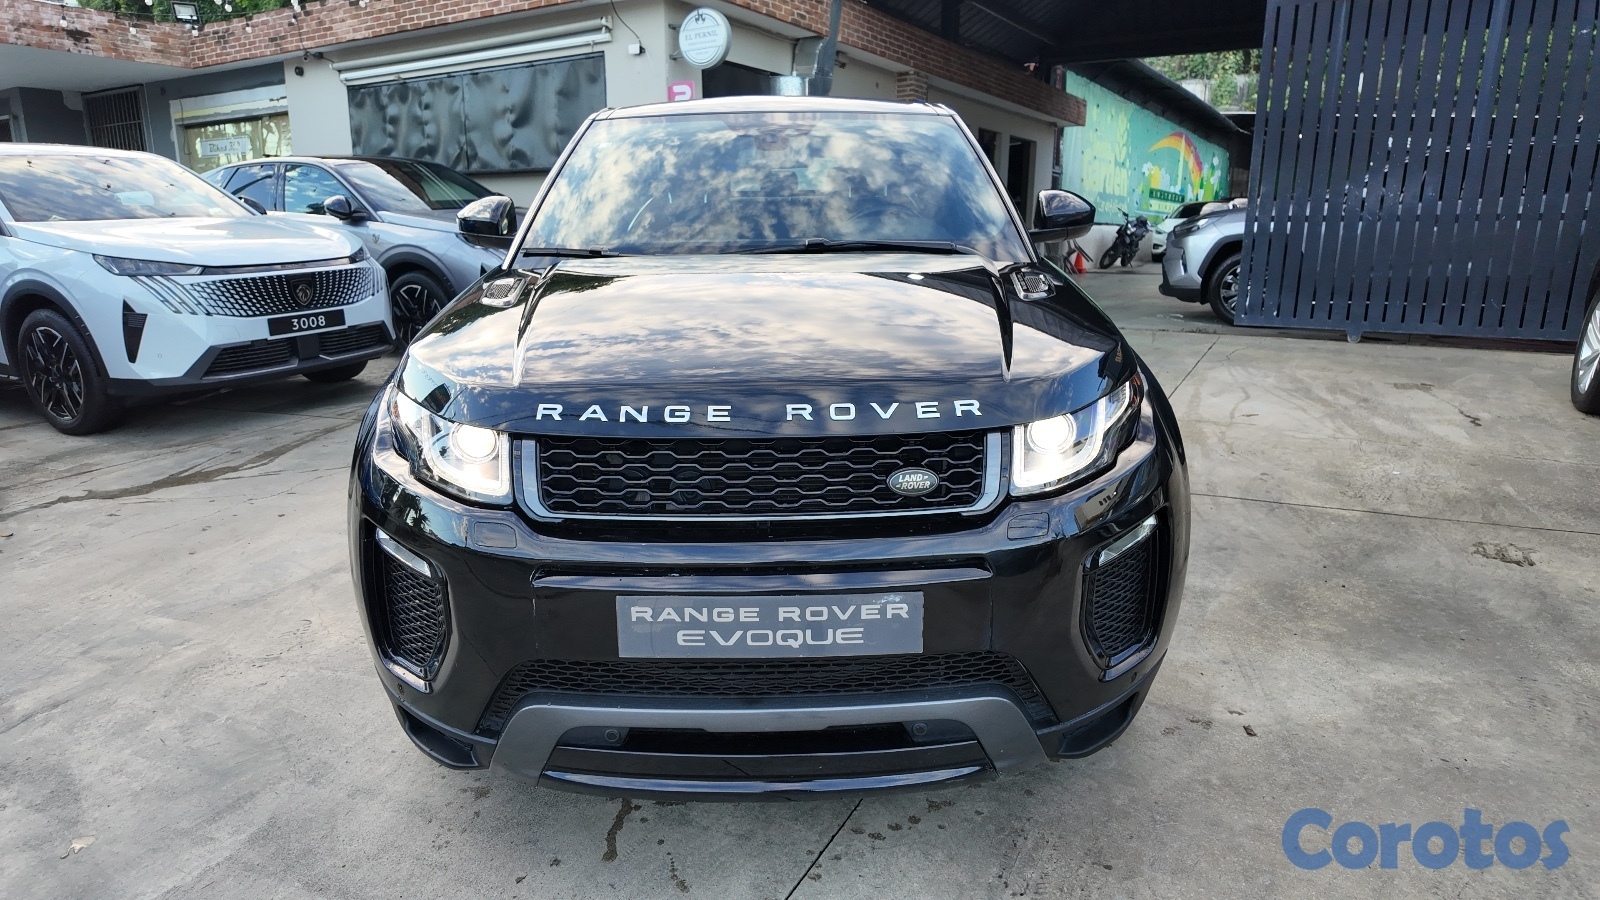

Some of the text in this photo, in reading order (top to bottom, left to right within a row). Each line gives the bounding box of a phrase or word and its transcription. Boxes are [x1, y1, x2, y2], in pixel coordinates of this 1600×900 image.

[694, 30, 718, 39] PERNIL
[291, 315, 326, 330] 3008
[535, 399, 983, 423] RANGE ROVER
[899, 474, 922, 482] LAND
[901, 481, 930, 489] ROVER
[630, 603, 909, 622] RANGE ROVER
[676, 627, 864, 648] EVOQUE
